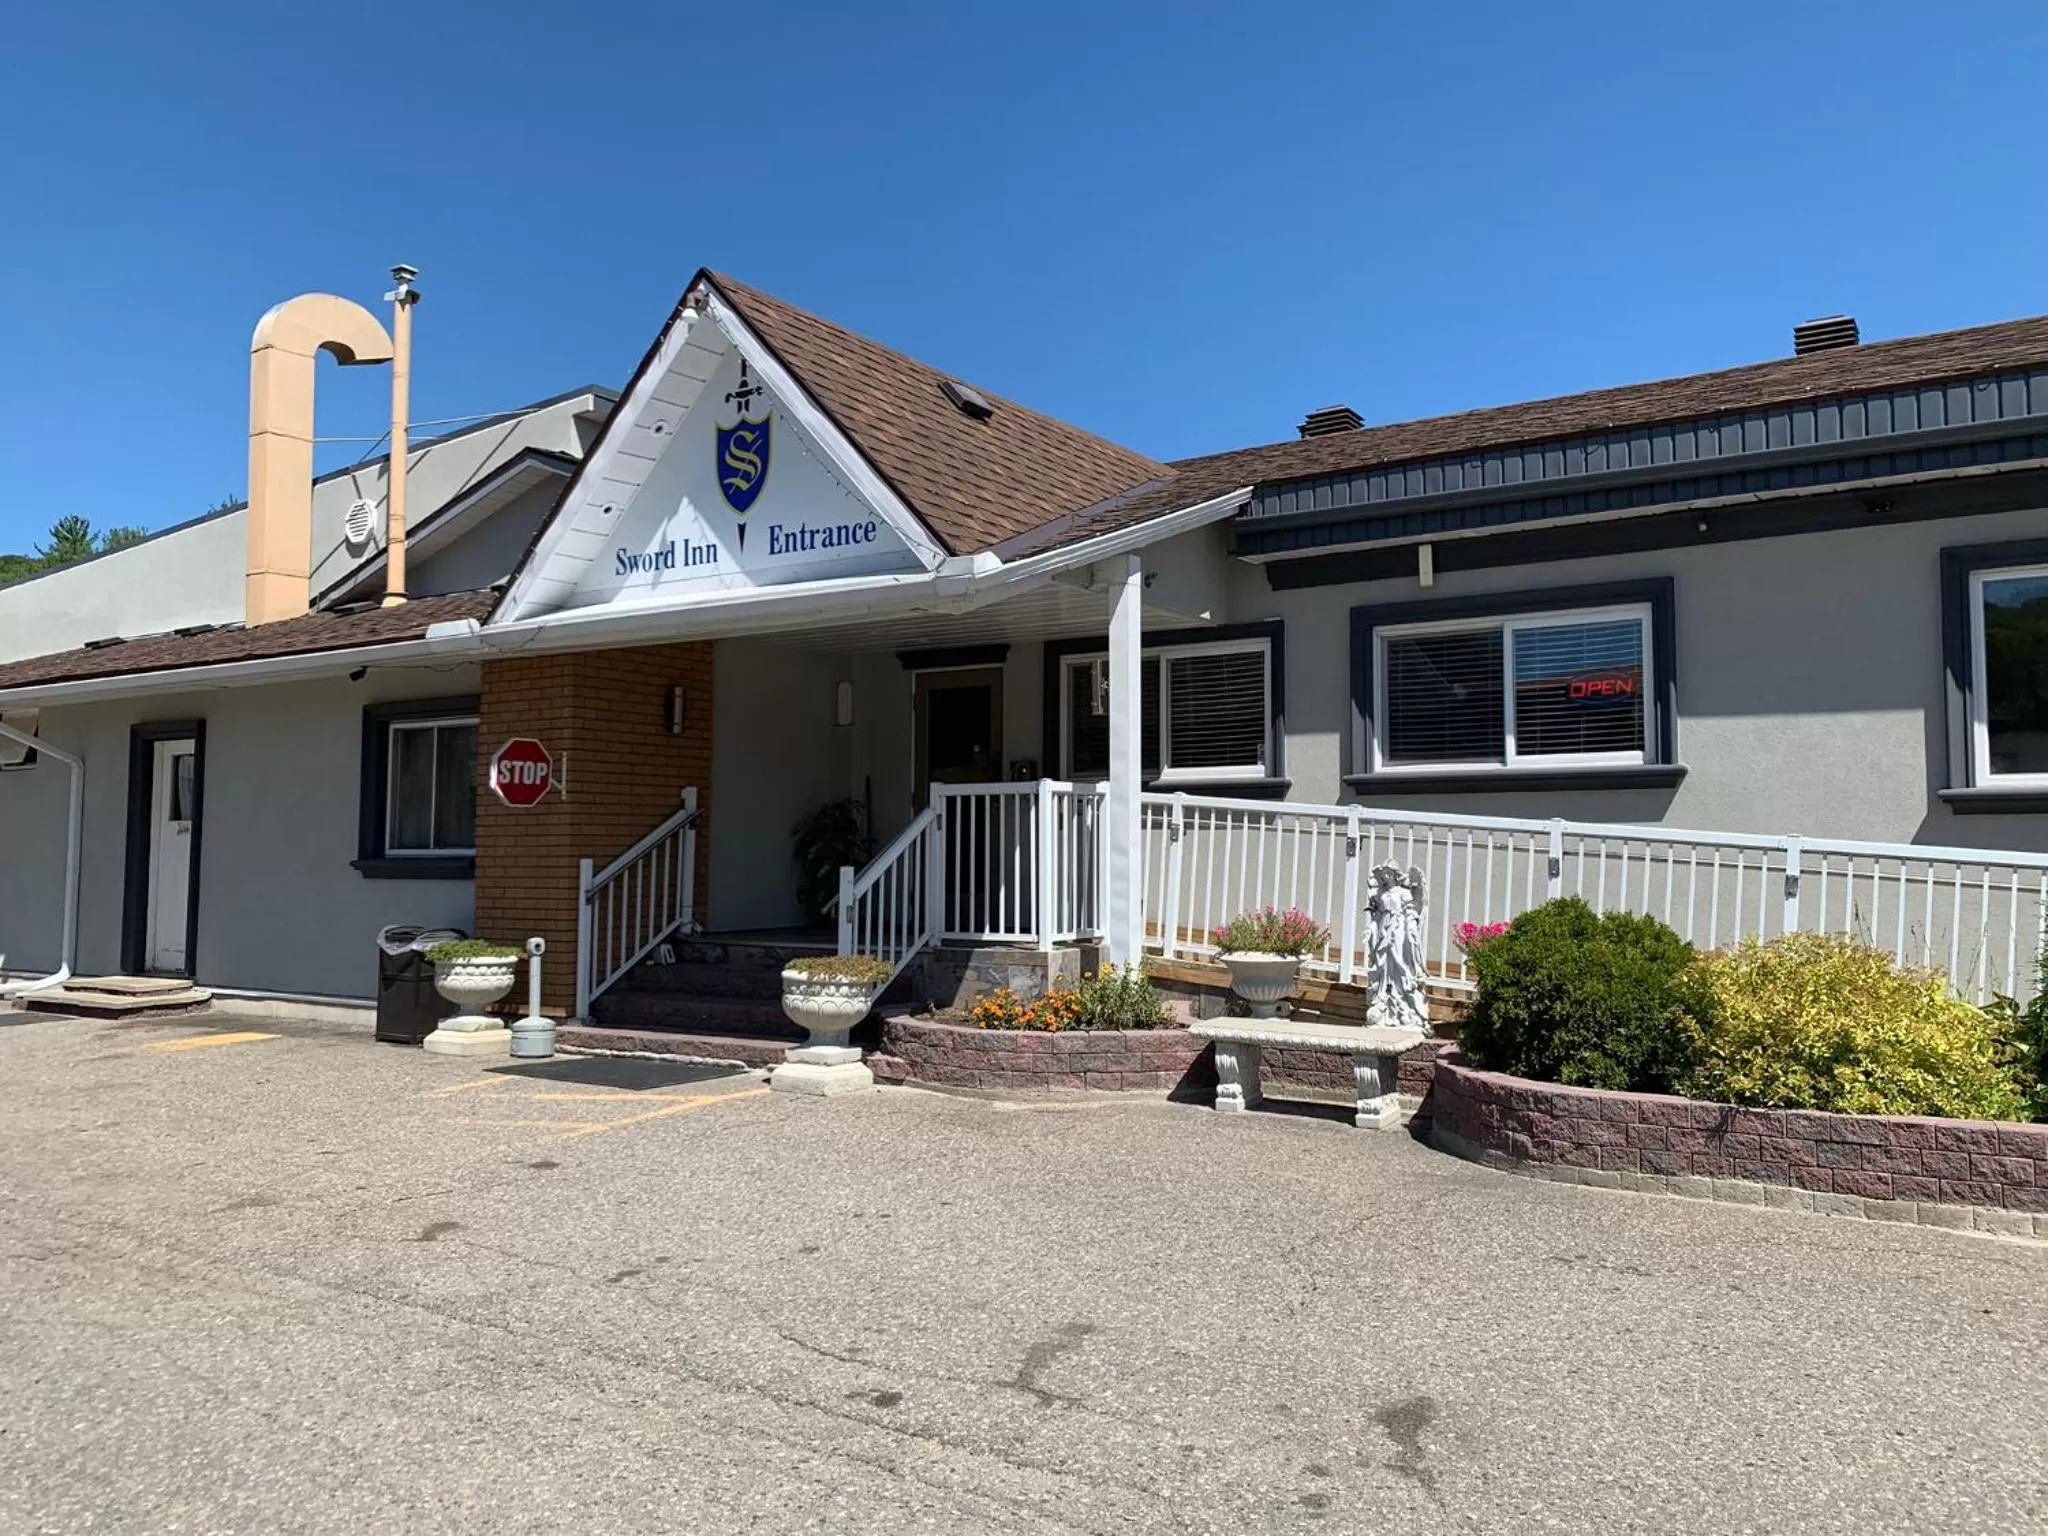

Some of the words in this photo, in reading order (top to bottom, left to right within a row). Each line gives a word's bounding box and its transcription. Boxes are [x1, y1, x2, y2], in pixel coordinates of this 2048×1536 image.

[723, 430, 762, 494] S
[768, 520, 877, 555] Entrance
[615, 541, 675, 576] Sword
[683, 538, 718, 566] Inn
[1569, 679, 1633, 697] OPEN
[499, 760, 548, 785] STOP
